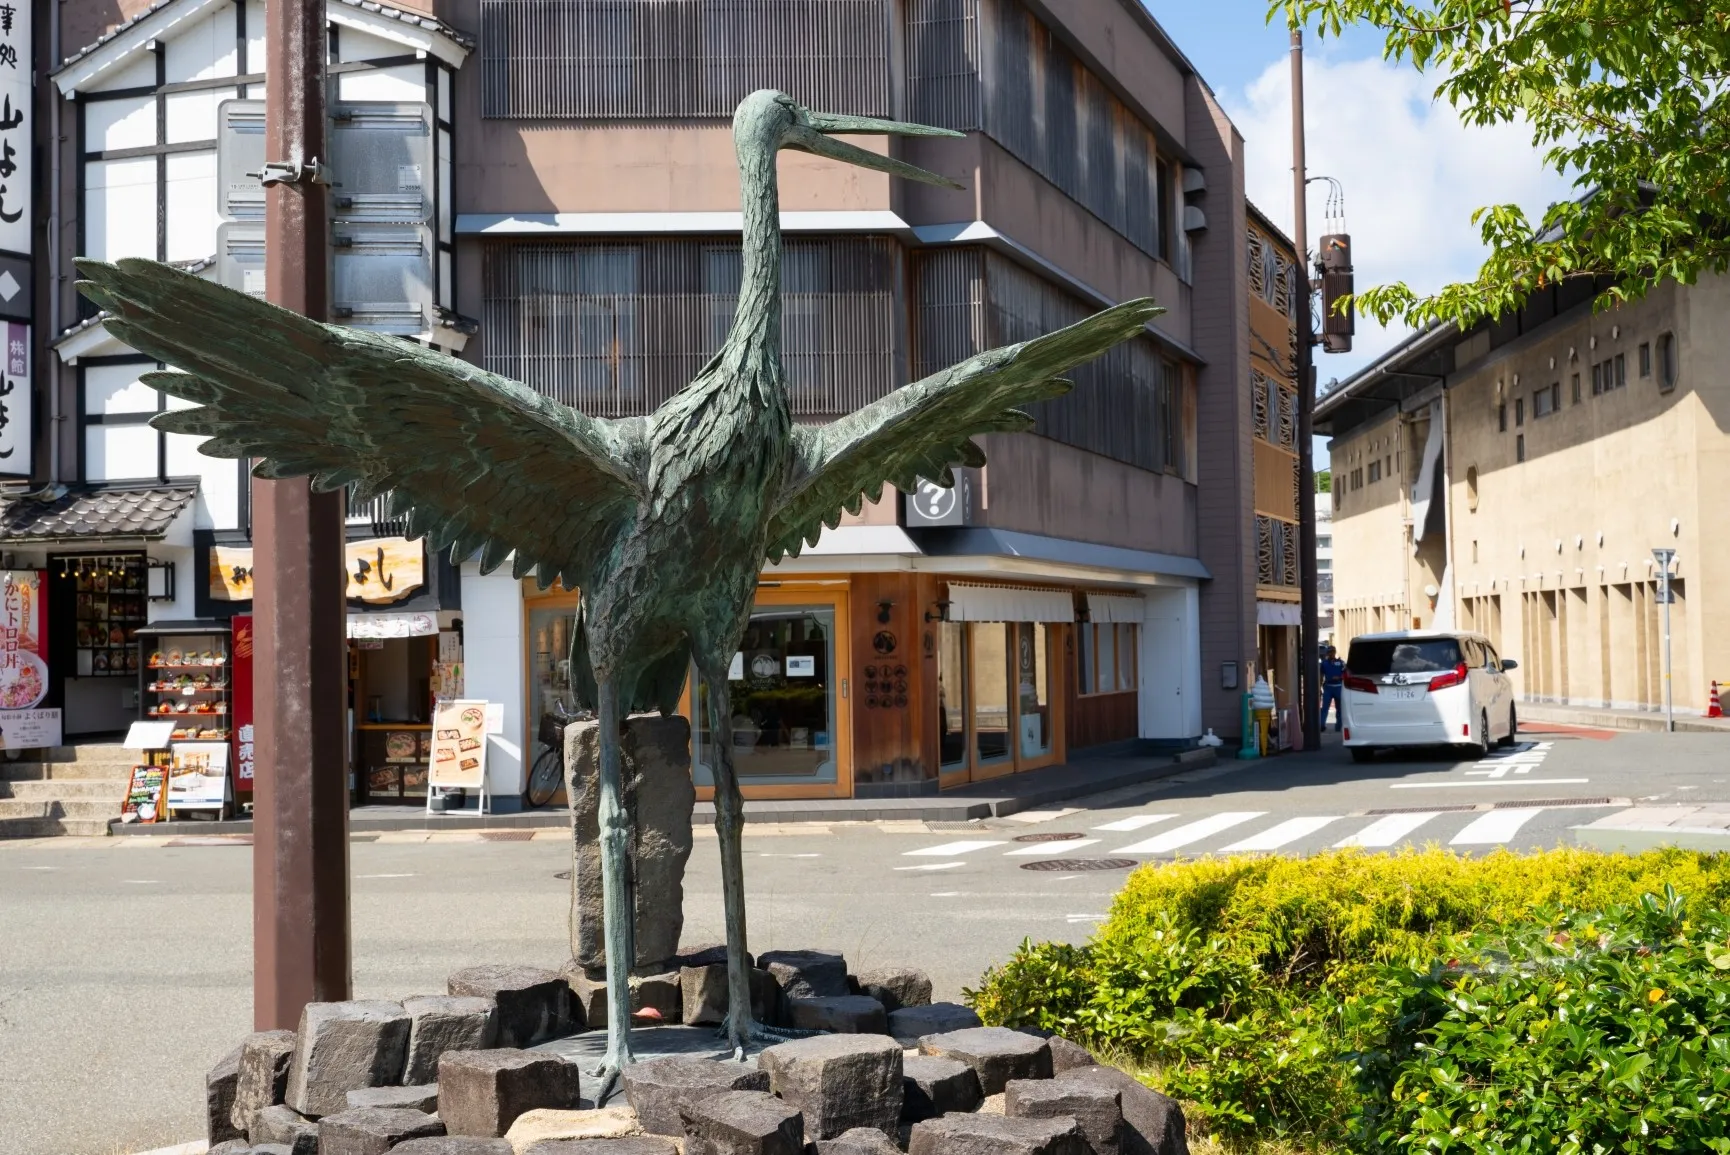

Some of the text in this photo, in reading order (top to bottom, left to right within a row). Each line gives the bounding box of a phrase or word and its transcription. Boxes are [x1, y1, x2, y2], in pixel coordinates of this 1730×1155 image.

[10, 340, 25, 374] 旅館
[4, 584, 19, 669] かにトロロ丼
